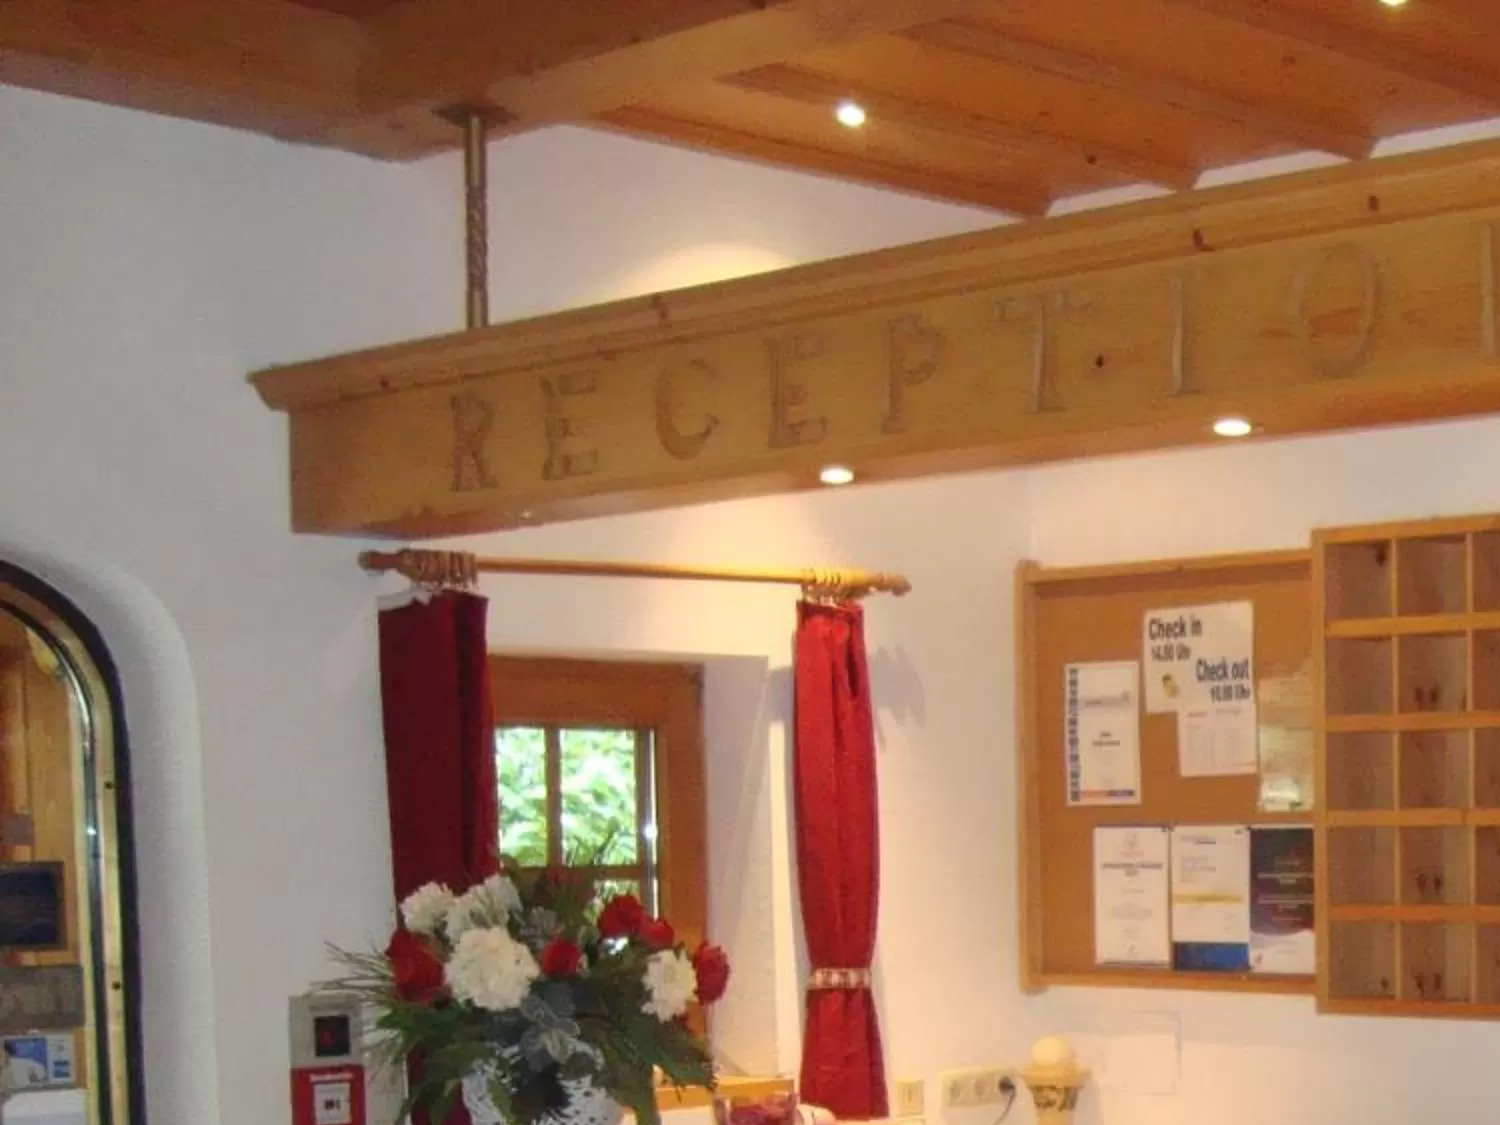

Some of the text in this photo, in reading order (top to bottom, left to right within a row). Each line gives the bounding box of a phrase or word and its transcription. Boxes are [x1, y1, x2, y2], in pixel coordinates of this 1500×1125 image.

[1149, 614, 1202, 640] Check in
[1196, 657, 1249, 682] Check out
